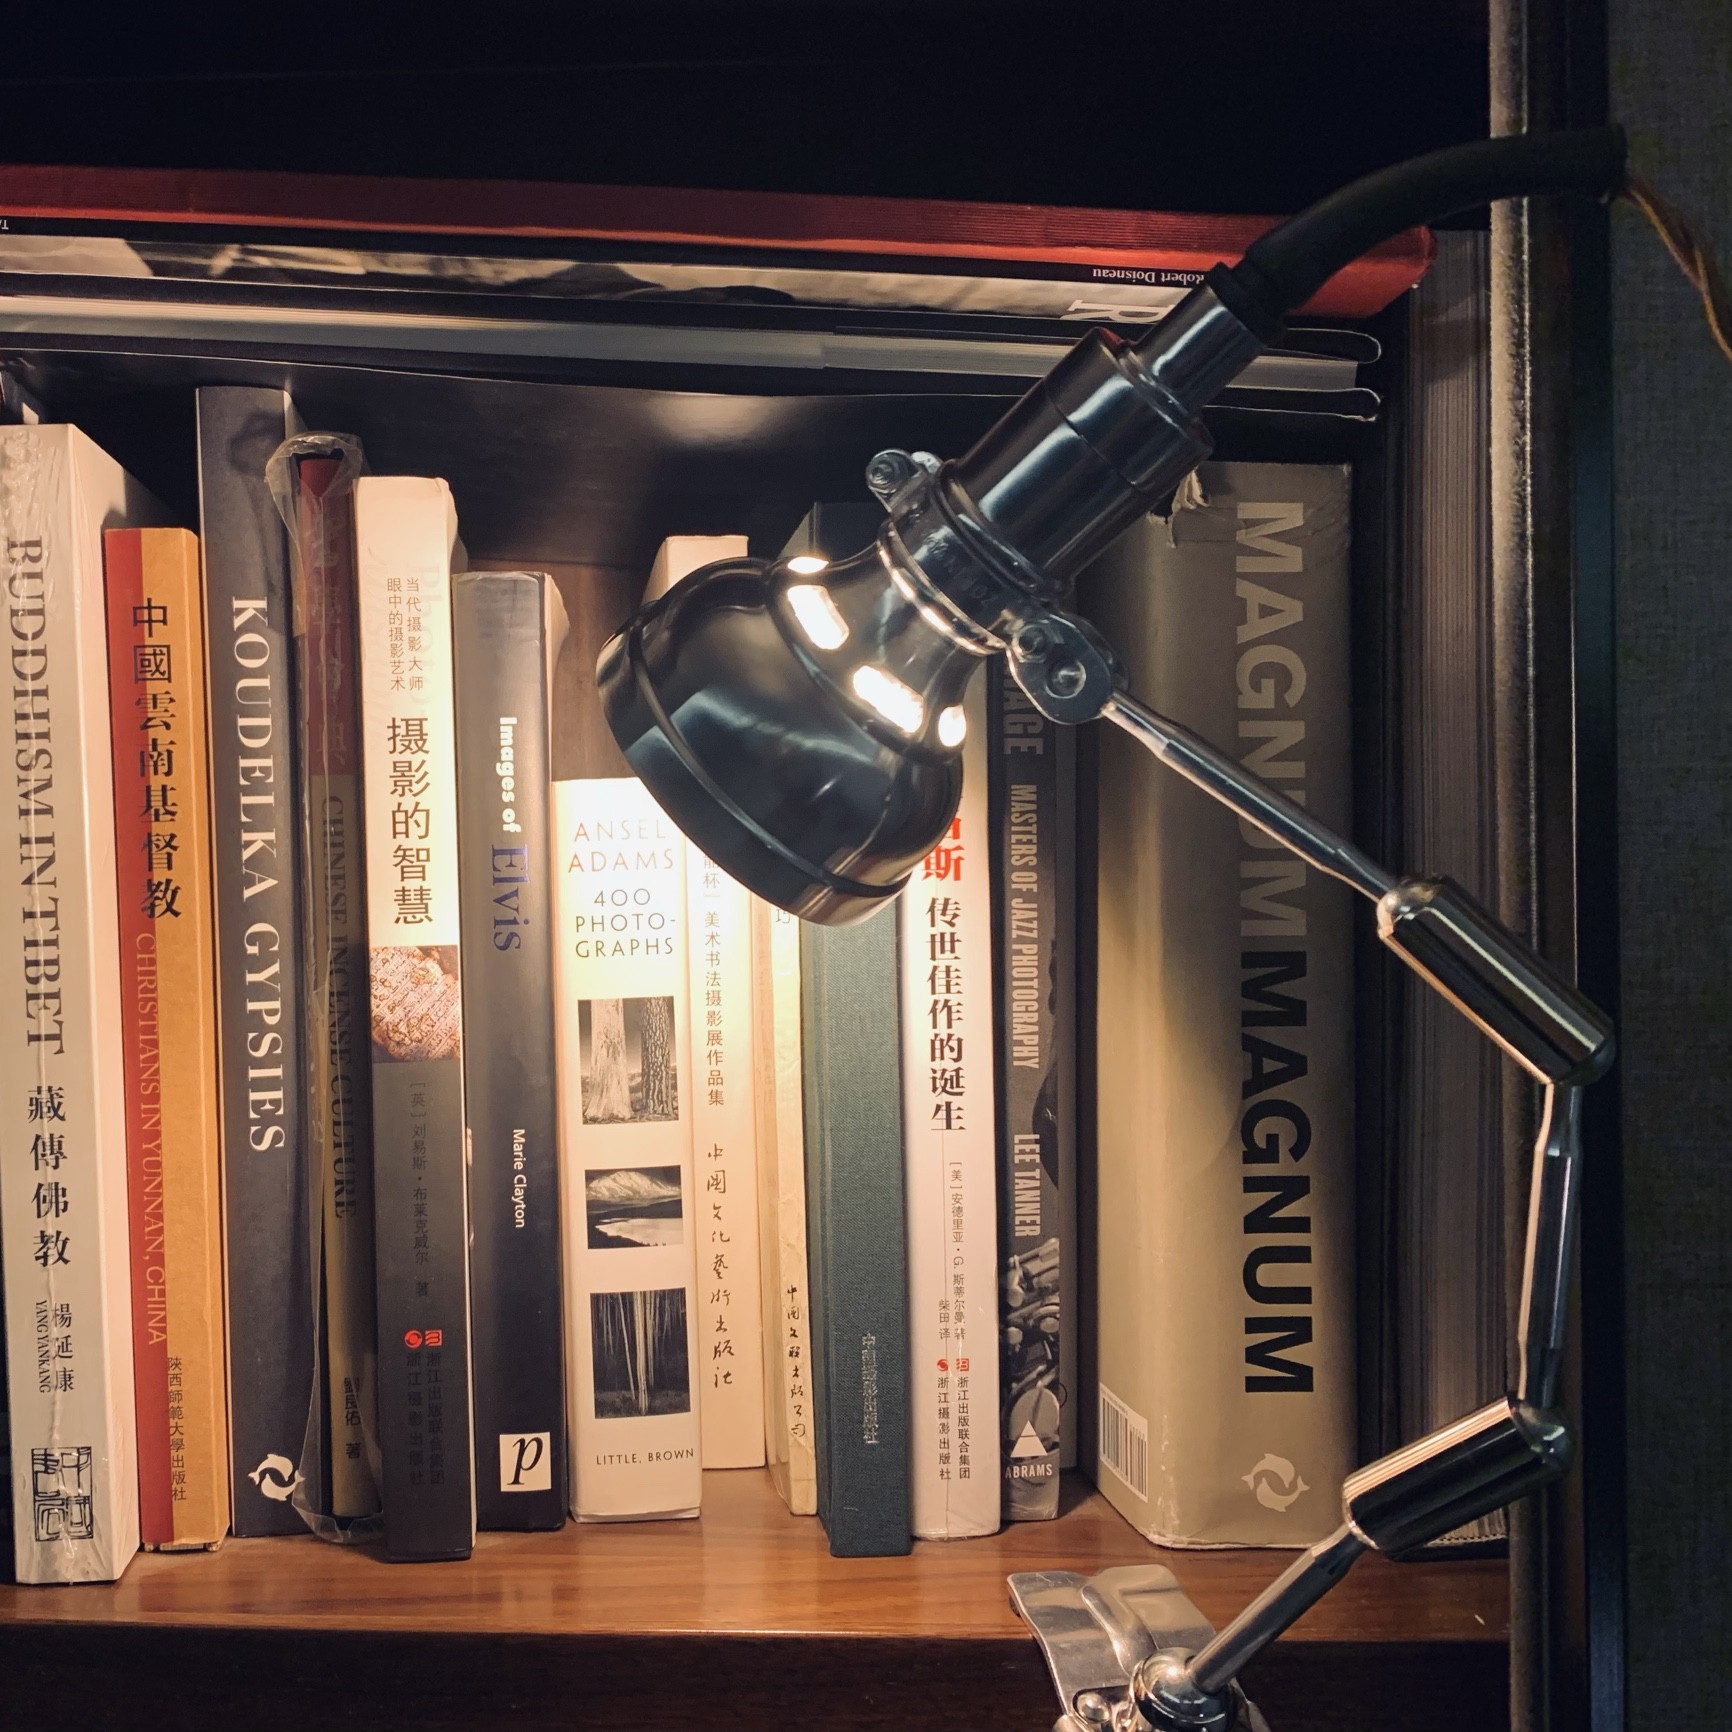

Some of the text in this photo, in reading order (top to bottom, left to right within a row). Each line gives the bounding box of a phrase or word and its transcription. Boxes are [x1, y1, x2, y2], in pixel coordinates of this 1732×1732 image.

[1092, 268, 1156, 283] Doisneau
[386, 576, 406, 692] 眼中的摄影艺术
[406, 576, 424, 692] 当代摄影大师
[7, 536, 64, 1055] BUDDHISM IN TIBET
[131, 596, 182, 920] 中國雲南基督教
[232, 597, 285, 1152] KOUDELKA GYPSIES
[321, 795, 348, 926] CHINESE
[386, 717, 433, 925] 摄影的智慧
[491, 717, 531, 953] Images of Elvis
[567, 848, 675, 874] ADAMS
[573, 820, 667, 844] ANSEL
[576, 936, 674, 959] GRAPHS
[593, 888, 651, 907] 400
[1011, 784, 1040, 1069] MASTERS OF JAZZ PHOTOGRAPHY
[135, 932, 161, 1094] CHRISTIANS
[925, 896, 967, 1131] 传世佳作的诞生
[140, 1102, 162, 1130] IN
[330, 1075, 357, 1219] CULTURE
[1240, 951, 1314, 1393] MAGNUM
[27, 1085, 70, 1268] 藏傳佛教
[512, 1128, 526, 1229] Marie Clayton
[1014, 1133, 1041, 1237] LEE TANNER
[36, 1299, 51, 1393] YANG YANKANG
[145, 1265, 168, 1346] CHINA
[648, 1447, 696, 1463] BROWN
[957, 1376, 971, 1480] 浙江出版联合集团
[1004, 1463, 1053, 1479] ABRAMS
